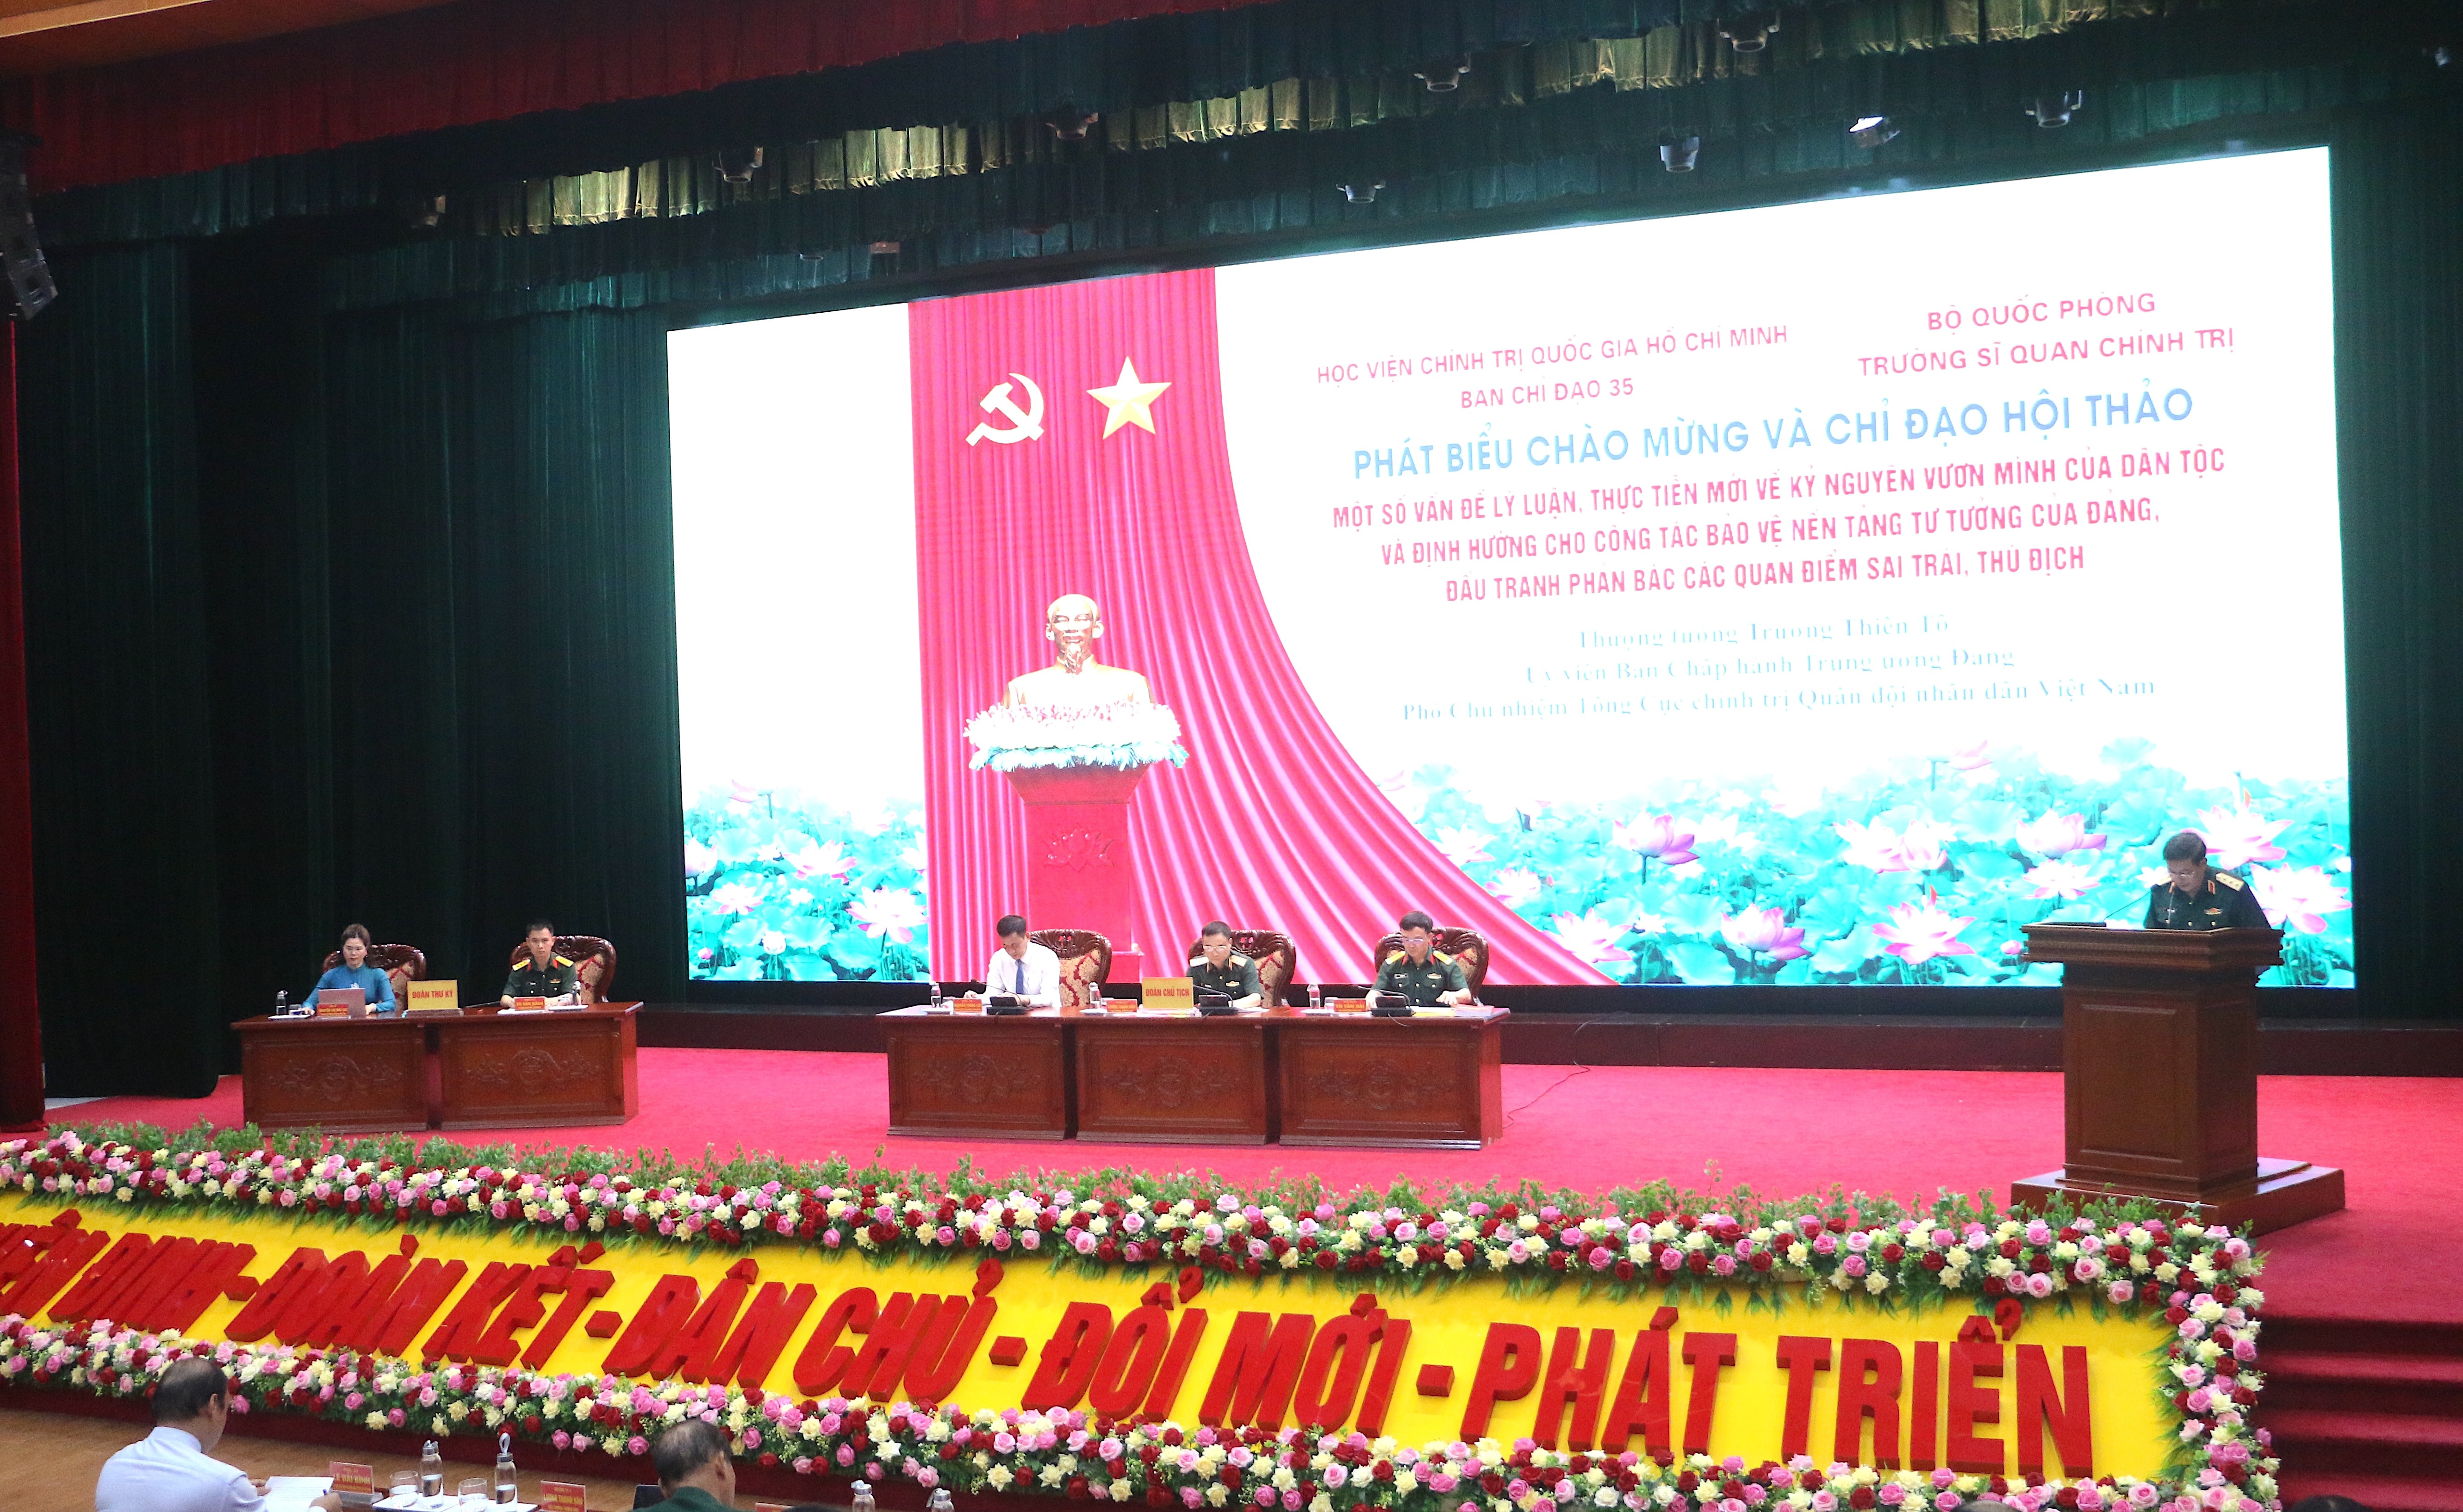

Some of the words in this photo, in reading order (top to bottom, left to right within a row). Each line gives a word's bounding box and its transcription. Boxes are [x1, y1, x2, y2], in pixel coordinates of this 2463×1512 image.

[1928, 305, 1961, 335] BỘ
[1972, 294, 2047, 327] QUỐC
[2060, 291, 2155, 319] PHÒNG
[1318, 364, 1358, 387] HỌC
[1367, 355, 1412, 382] VIỆN
[1421, 349, 1483, 374] CHÍNH
[1492, 348, 1522, 372] TRỊ
[1531, 335, 1592, 364] QUỐC
[1601, 339, 1638, 359] GIA
[1647, 327, 1676, 354] HỒ
[1686, 326, 1720, 351] CHÍ
[1730, 325, 1786, 347] MINH
[1858, 348, 1966, 376] TRƯỜNG
[1978, 341, 1999, 367] SĨ
[2010, 340, 2088, 364] QUAN
[2099, 329, 2183, 357] CHÍNH
[2194, 328, 2233, 353] TRỊ
[1610, 378, 1633, 396] 35
[1355, 437, 1433, 479] PHÁT
[1447, 422, 1512, 472] BIỂU
[1527, 423, 1628, 466] CHÀO
[1644, 416, 1748, 458] MỪNG
[1764, 407, 1810, 449] VÀ
[1825, 398, 1888, 444] CHỈ
[1904, 403, 1987, 446] ĐẠO
[2003, 389, 2069, 440] HỘI
[2085, 378, 2193, 427] THẢO
[1333, 502, 1373, 532] MỘT
[1382, 495, 1406, 525] SỐ
[1414, 493, 1453, 522] VẤN
[1461, 489, 1485, 519] ĐỀ
[1494, 491, 1514, 517] LÝ
[1590, 485, 1643, 514] THỰC
[1651, 475, 1697, 507] TIỄN
[1707, 473, 1747, 503] MỚI
[1756, 469, 1780, 500] VỀ
[1791, 465, 1815, 498] KỶ
[1825, 465, 1915, 496] NGUYÊN
[1924, 463, 1984, 490] VƯƠN
[1995, 457, 2055, 485] MÌNH
[2065, 447, 2112, 481] CỦA
[2121, 447, 2170, 477] DÂN
[2180, 444, 2224, 478] TỘC
[1446, 571, 1485, 601] ĐẤU
[1493, 575, 1559, 599] TRANH
[1634, 564, 1674, 591] BÁC
[1684, 561, 1725, 589] CÁC
[1735, 562, 1793, 589] QUAN
[1867, 556, 1902, 580] SAI
[2029, 545, 2084, 576] ĐỊCH
[2097, 678, 2154, 695] Nam
[1176, 988, 1189, 998] TỊCH
[422, 1241, 615, 1371] KẾT
[601, 1258, 817, 1389] DÂN
[793, 1258, 1004, 1405] CHỦ
[1021, 1266, 1208, 1423] ĐỔI
[1199, 1294, 1412, 1439] MỚI
[1460, 1306, 1737, 1456] PHÁT
[1776, 1298, 2093, 1478] TRIỂN
